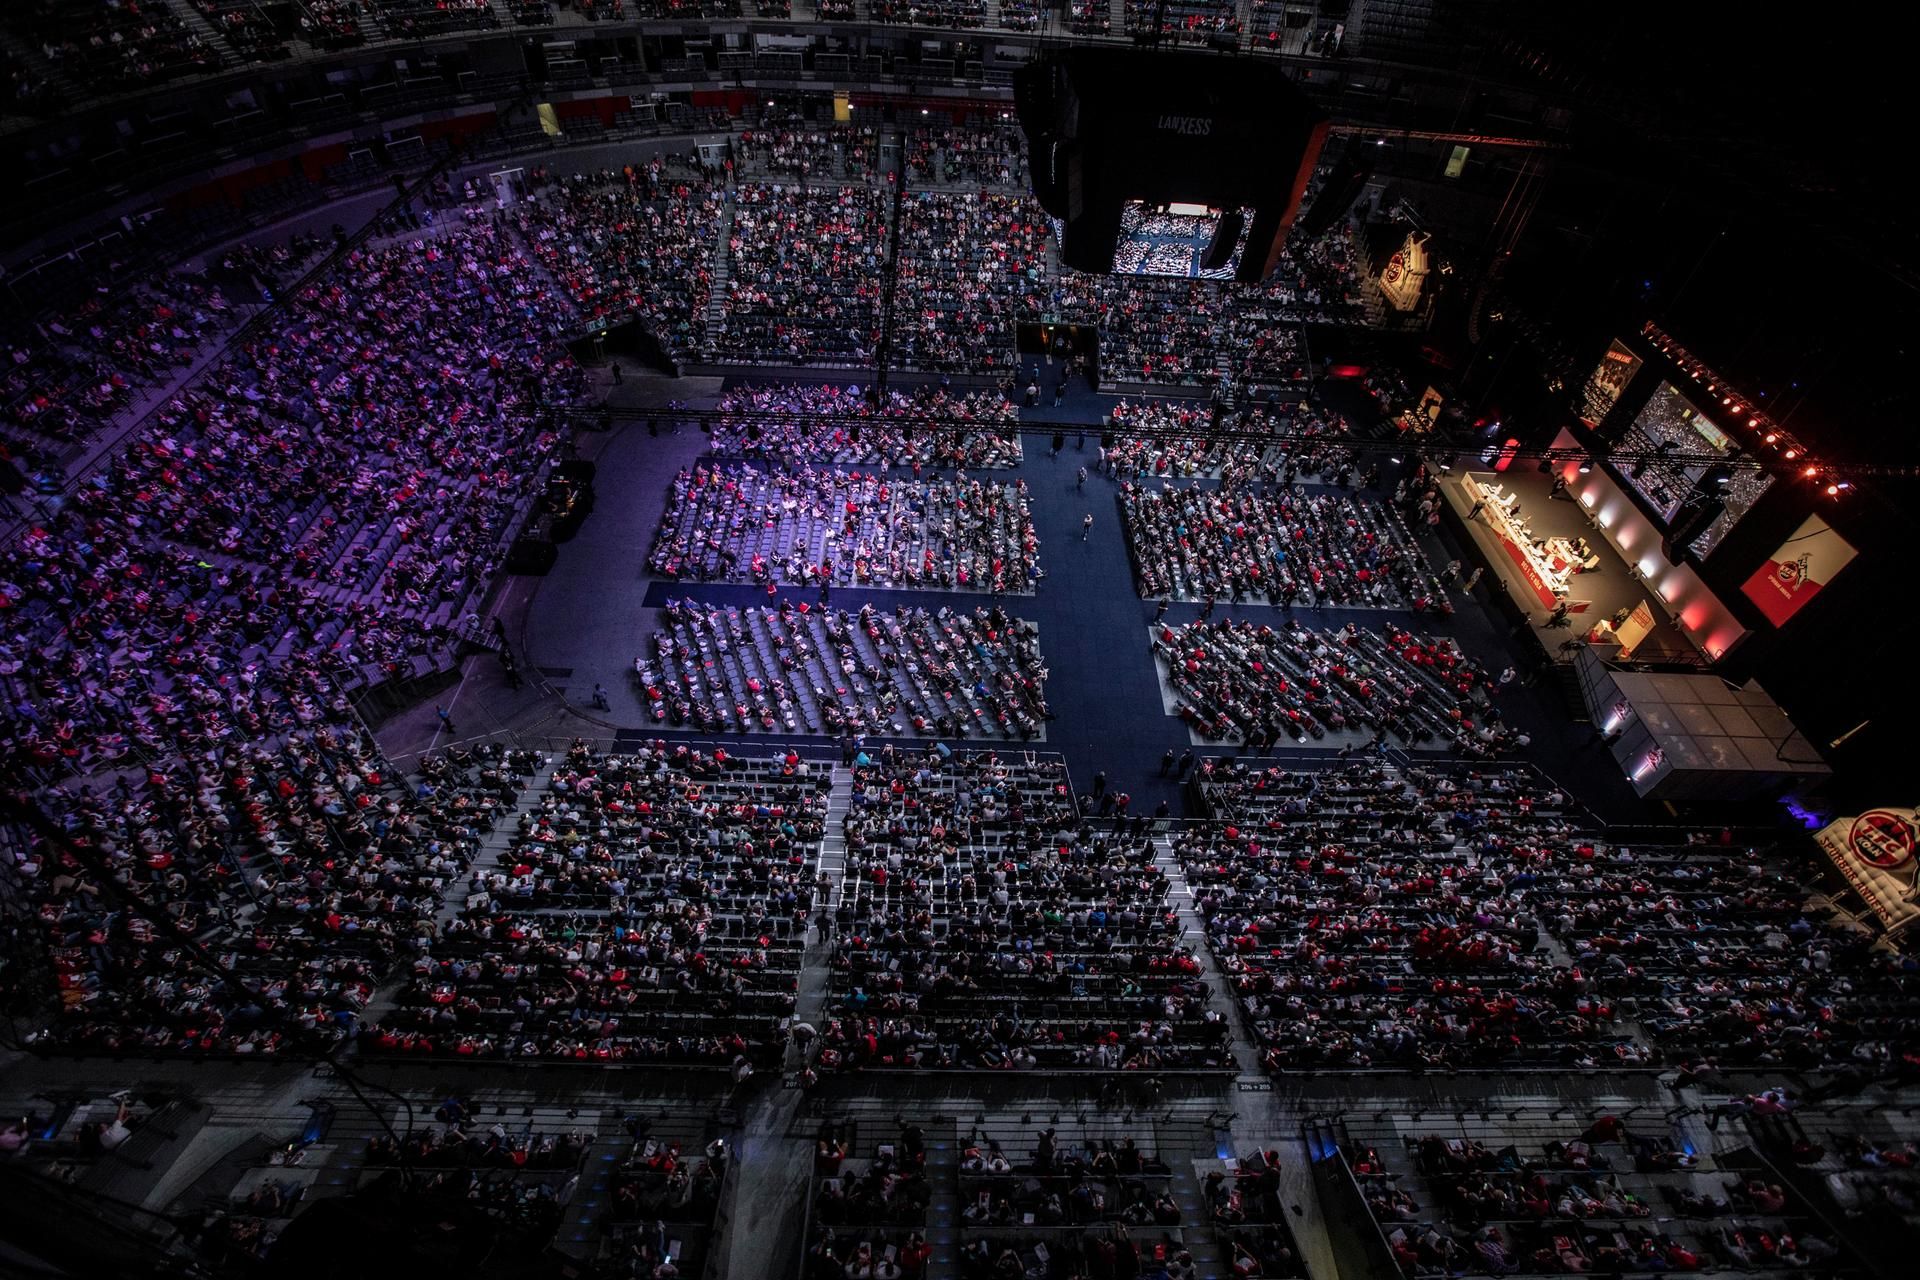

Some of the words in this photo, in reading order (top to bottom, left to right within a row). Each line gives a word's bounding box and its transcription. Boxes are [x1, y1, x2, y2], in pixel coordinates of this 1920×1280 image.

[1157, 115, 1213, 136] LANXESS
[1820, 836, 1858, 881] SPÜRBAR
[1855, 837, 1884, 859] KÖLN
